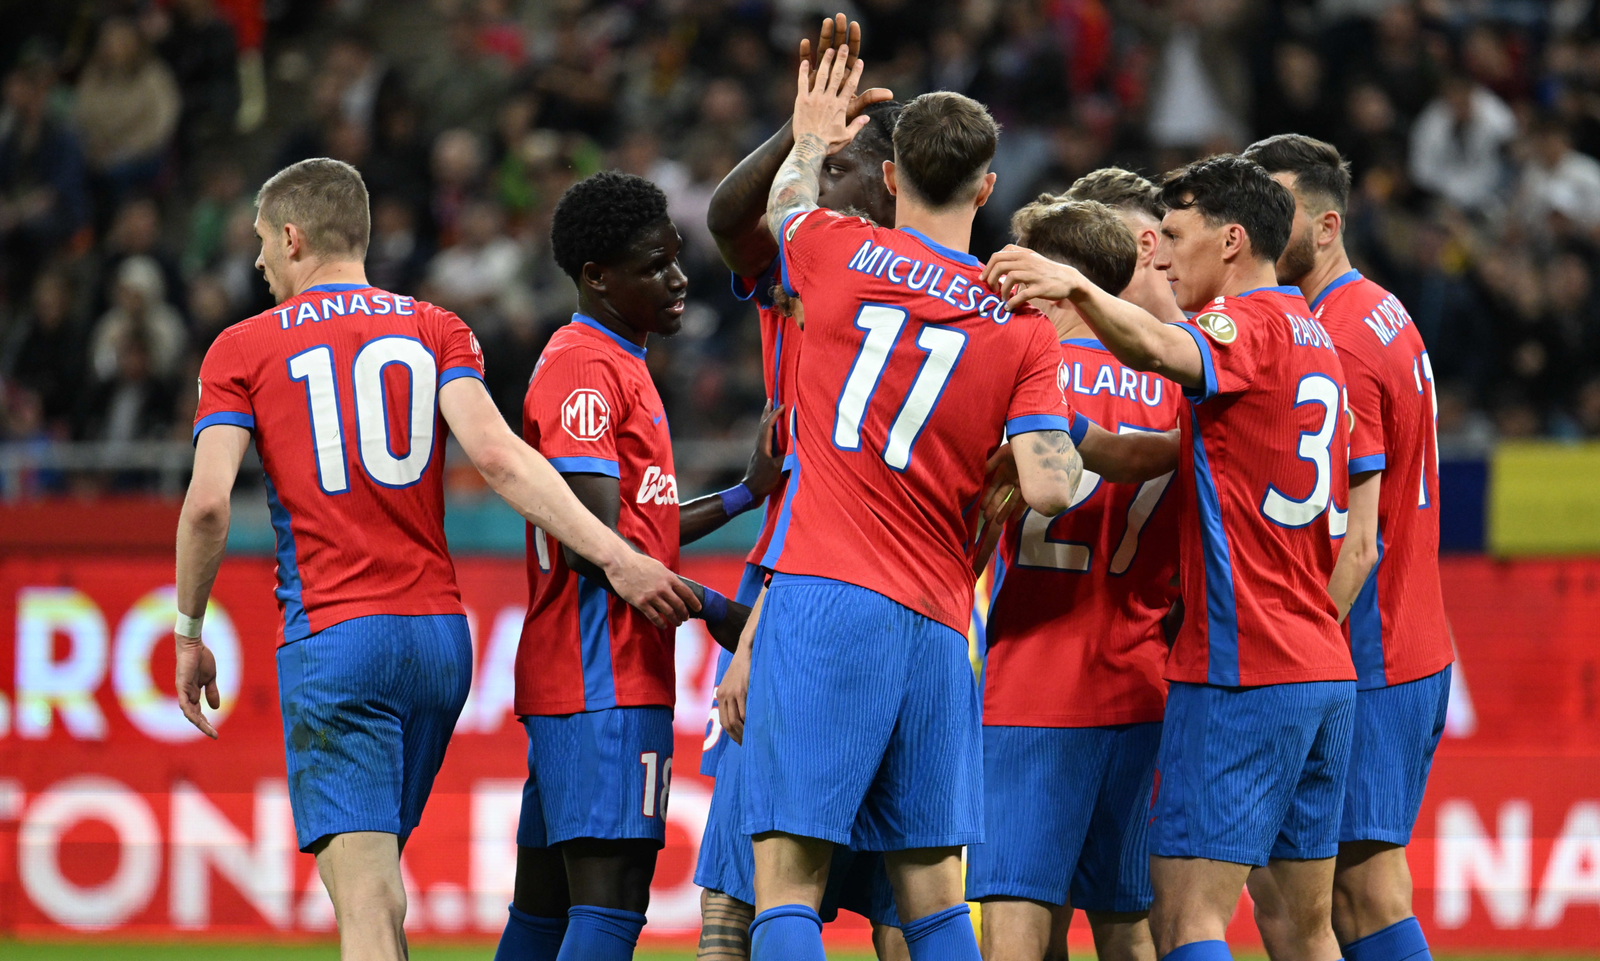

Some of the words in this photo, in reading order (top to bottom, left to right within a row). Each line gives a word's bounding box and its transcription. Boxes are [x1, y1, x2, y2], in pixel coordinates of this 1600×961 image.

[272, 292, 415, 331] TANASE
[847, 239, 1013, 325] MICULESCU
[286, 333, 439, 497] 10
[566, 393, 607, 437] MG
[832, 301, 970, 474] 11
